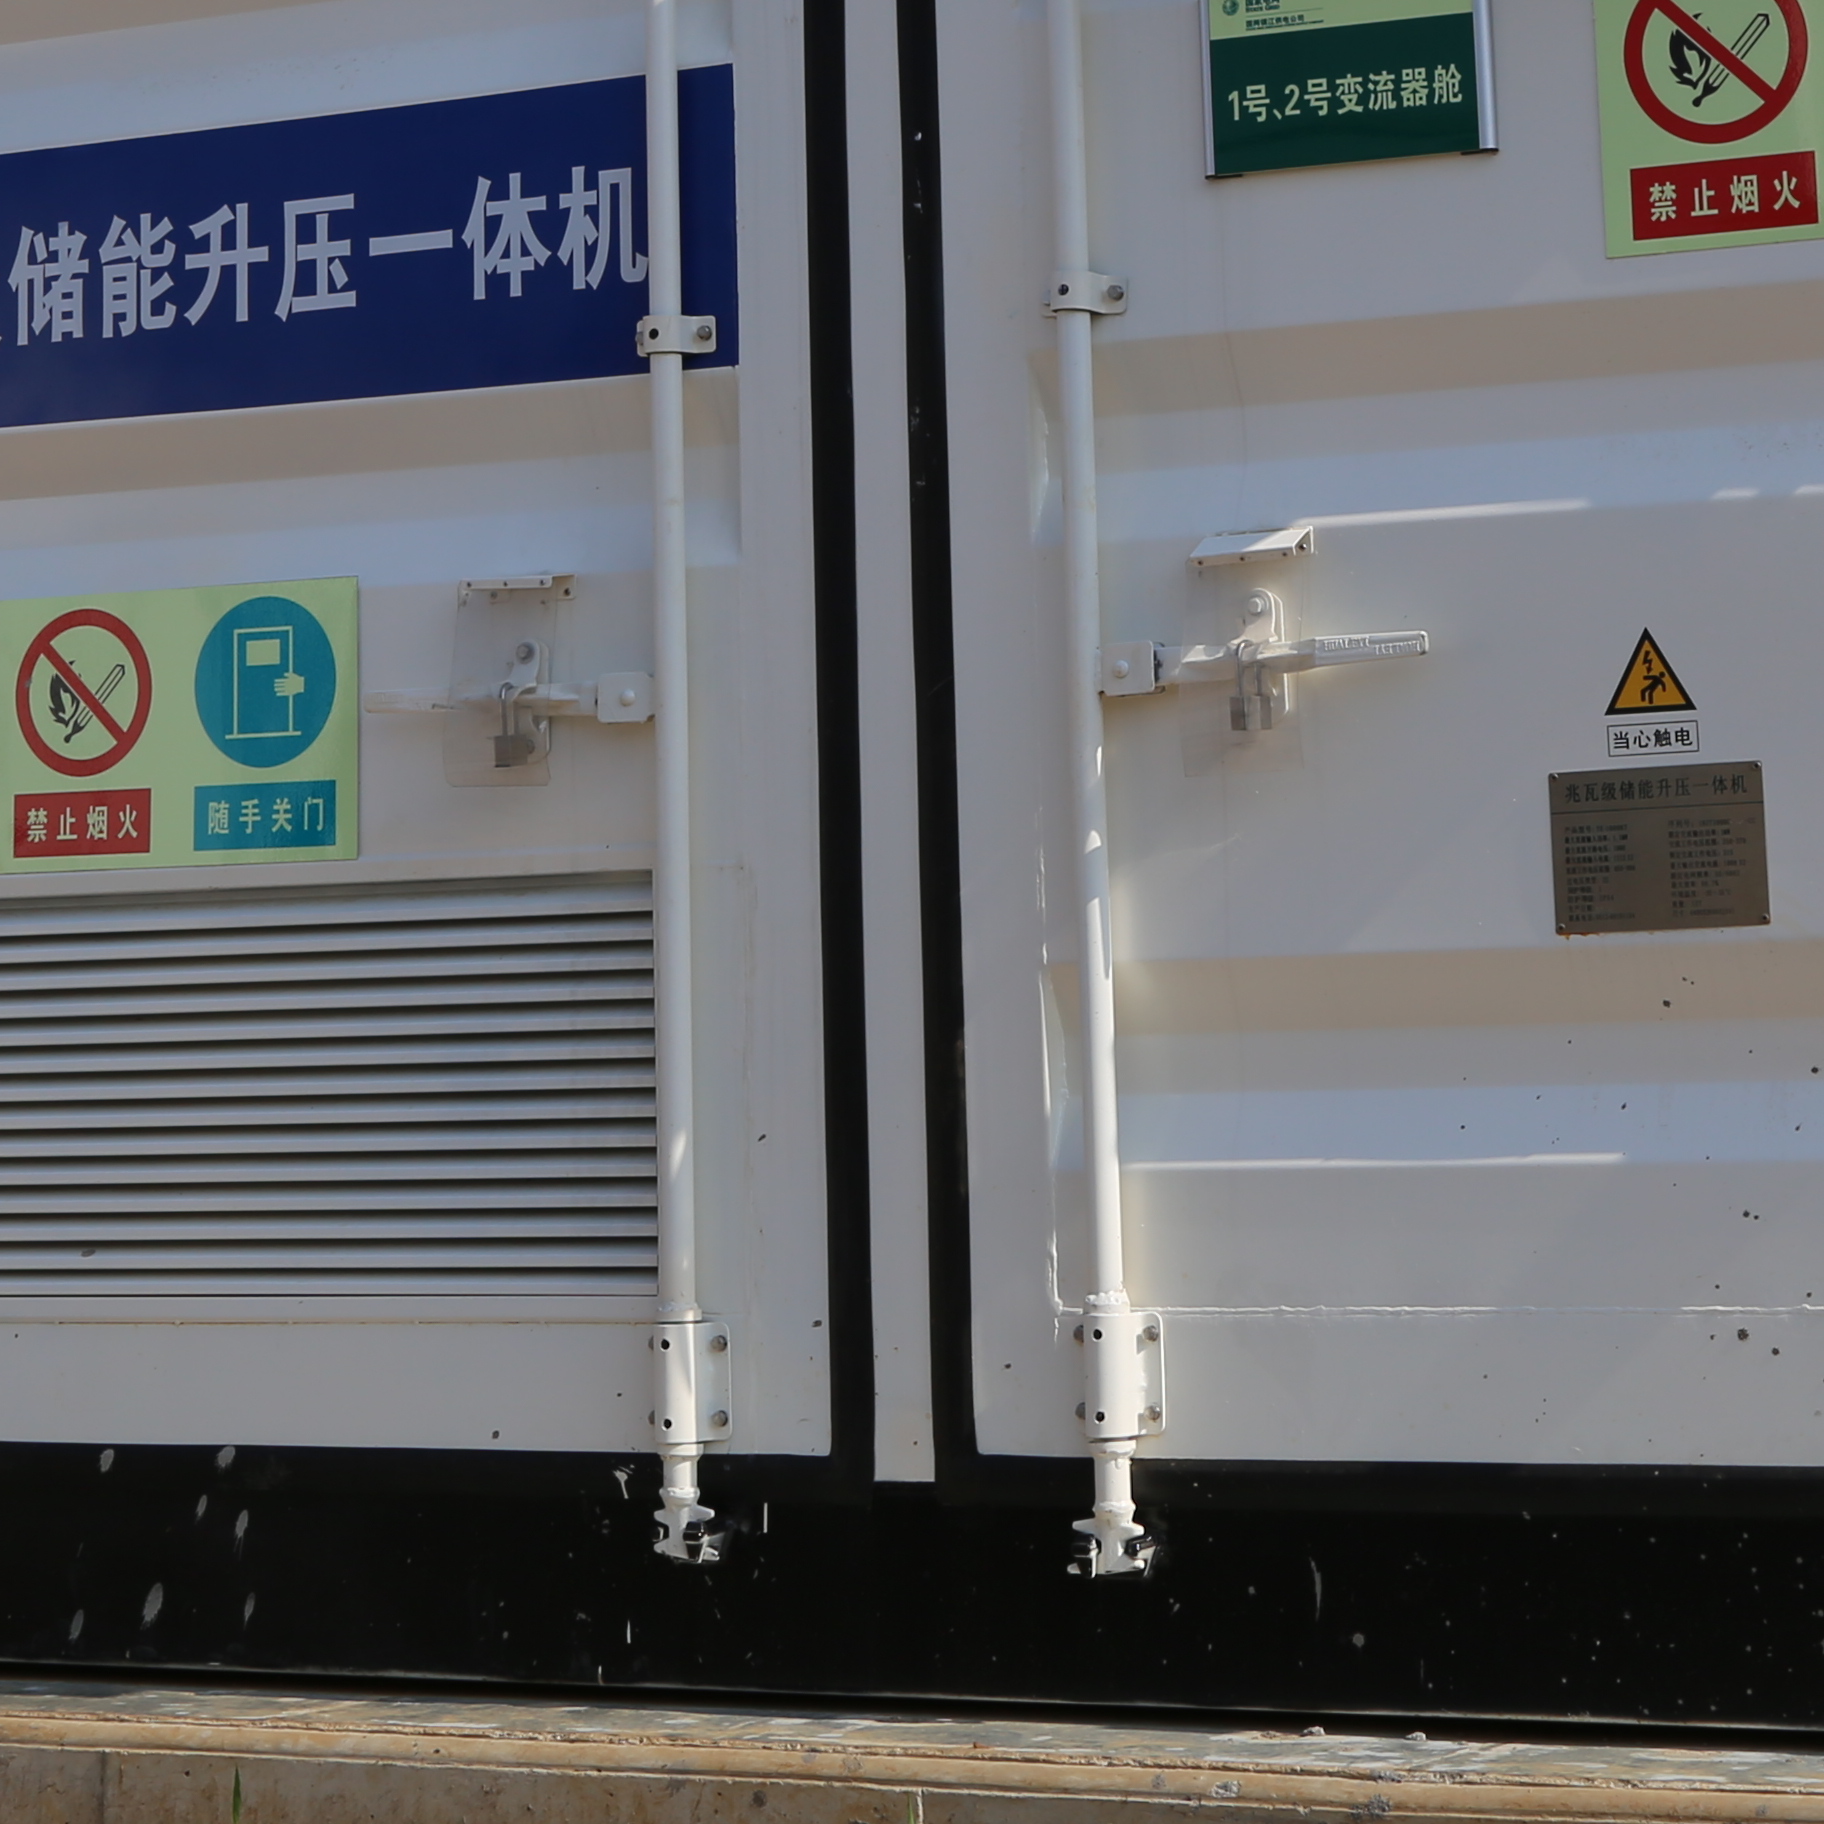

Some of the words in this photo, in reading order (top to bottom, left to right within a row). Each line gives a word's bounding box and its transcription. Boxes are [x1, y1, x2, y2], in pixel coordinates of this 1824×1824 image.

[1228, 63, 1462, 123] 1号、2号变流器舱
[1648, 170, 1801, 222] 禁止烟火
[1612, 727, 1694, 751] 当心触电
[1564, 774, 1748, 804] 兆瓦级储能升压一体机
[26, 804, 138, 843] 禁止烟火
[207, 796, 324, 835] 随手关门
